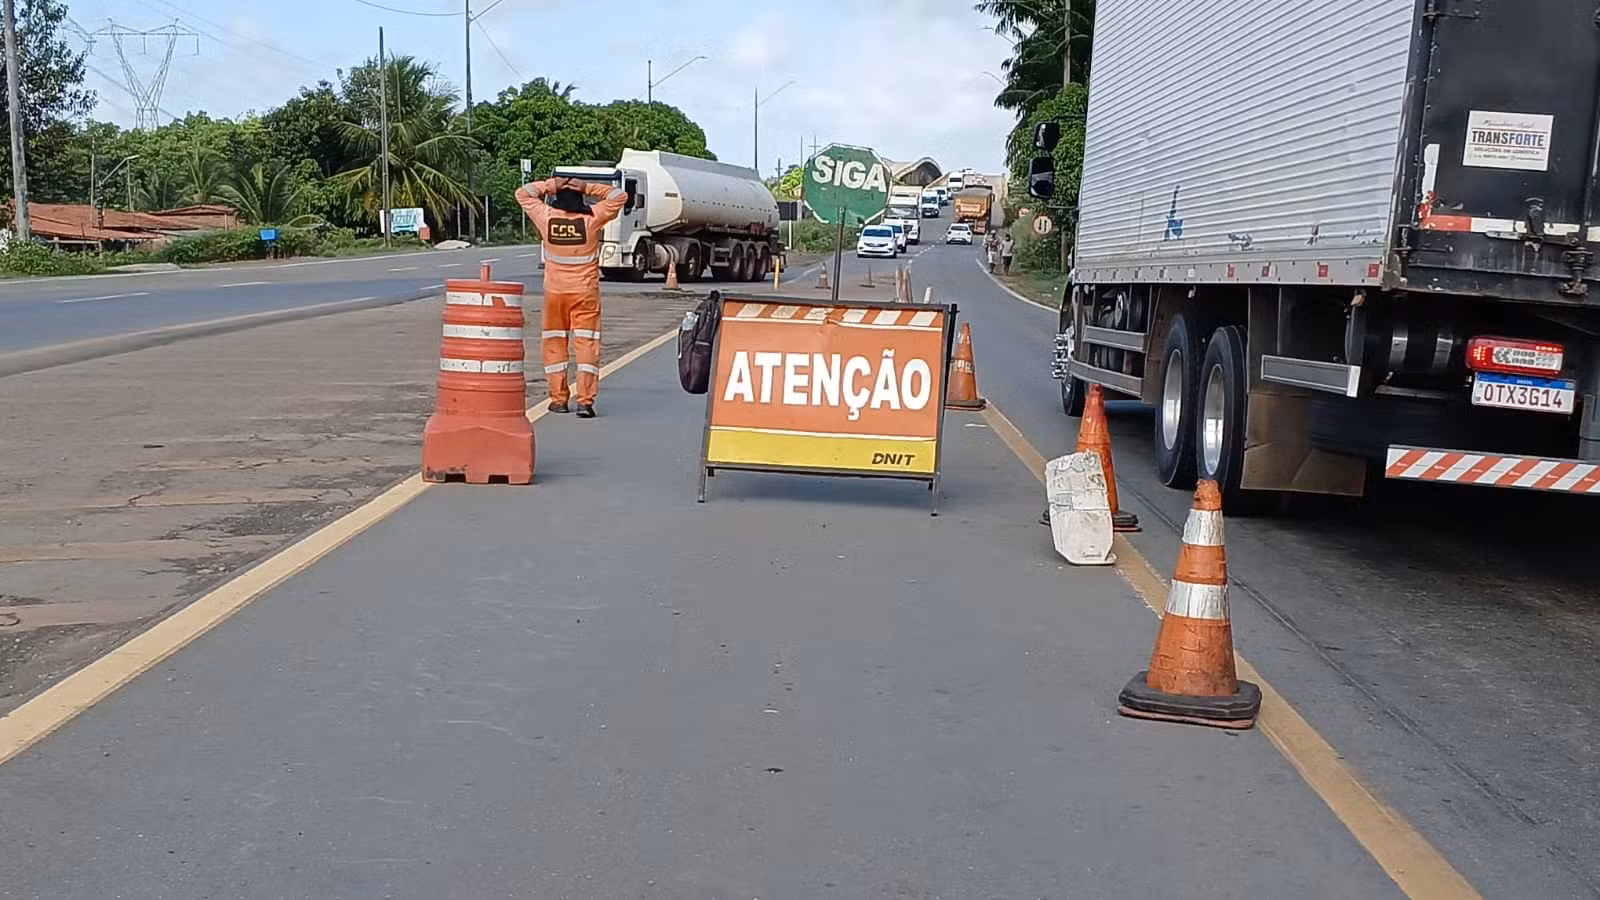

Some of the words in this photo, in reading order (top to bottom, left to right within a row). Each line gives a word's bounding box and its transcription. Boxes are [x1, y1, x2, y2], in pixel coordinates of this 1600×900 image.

[1472, 130, 1544, 147] TRANSFORTE
[812, 155, 887, 193] SIGA
[723, 349, 931, 421] ATENÇÃO
[1484, 384, 1562, 408] OTX3G14
[871, 453, 915, 465] DNIT
